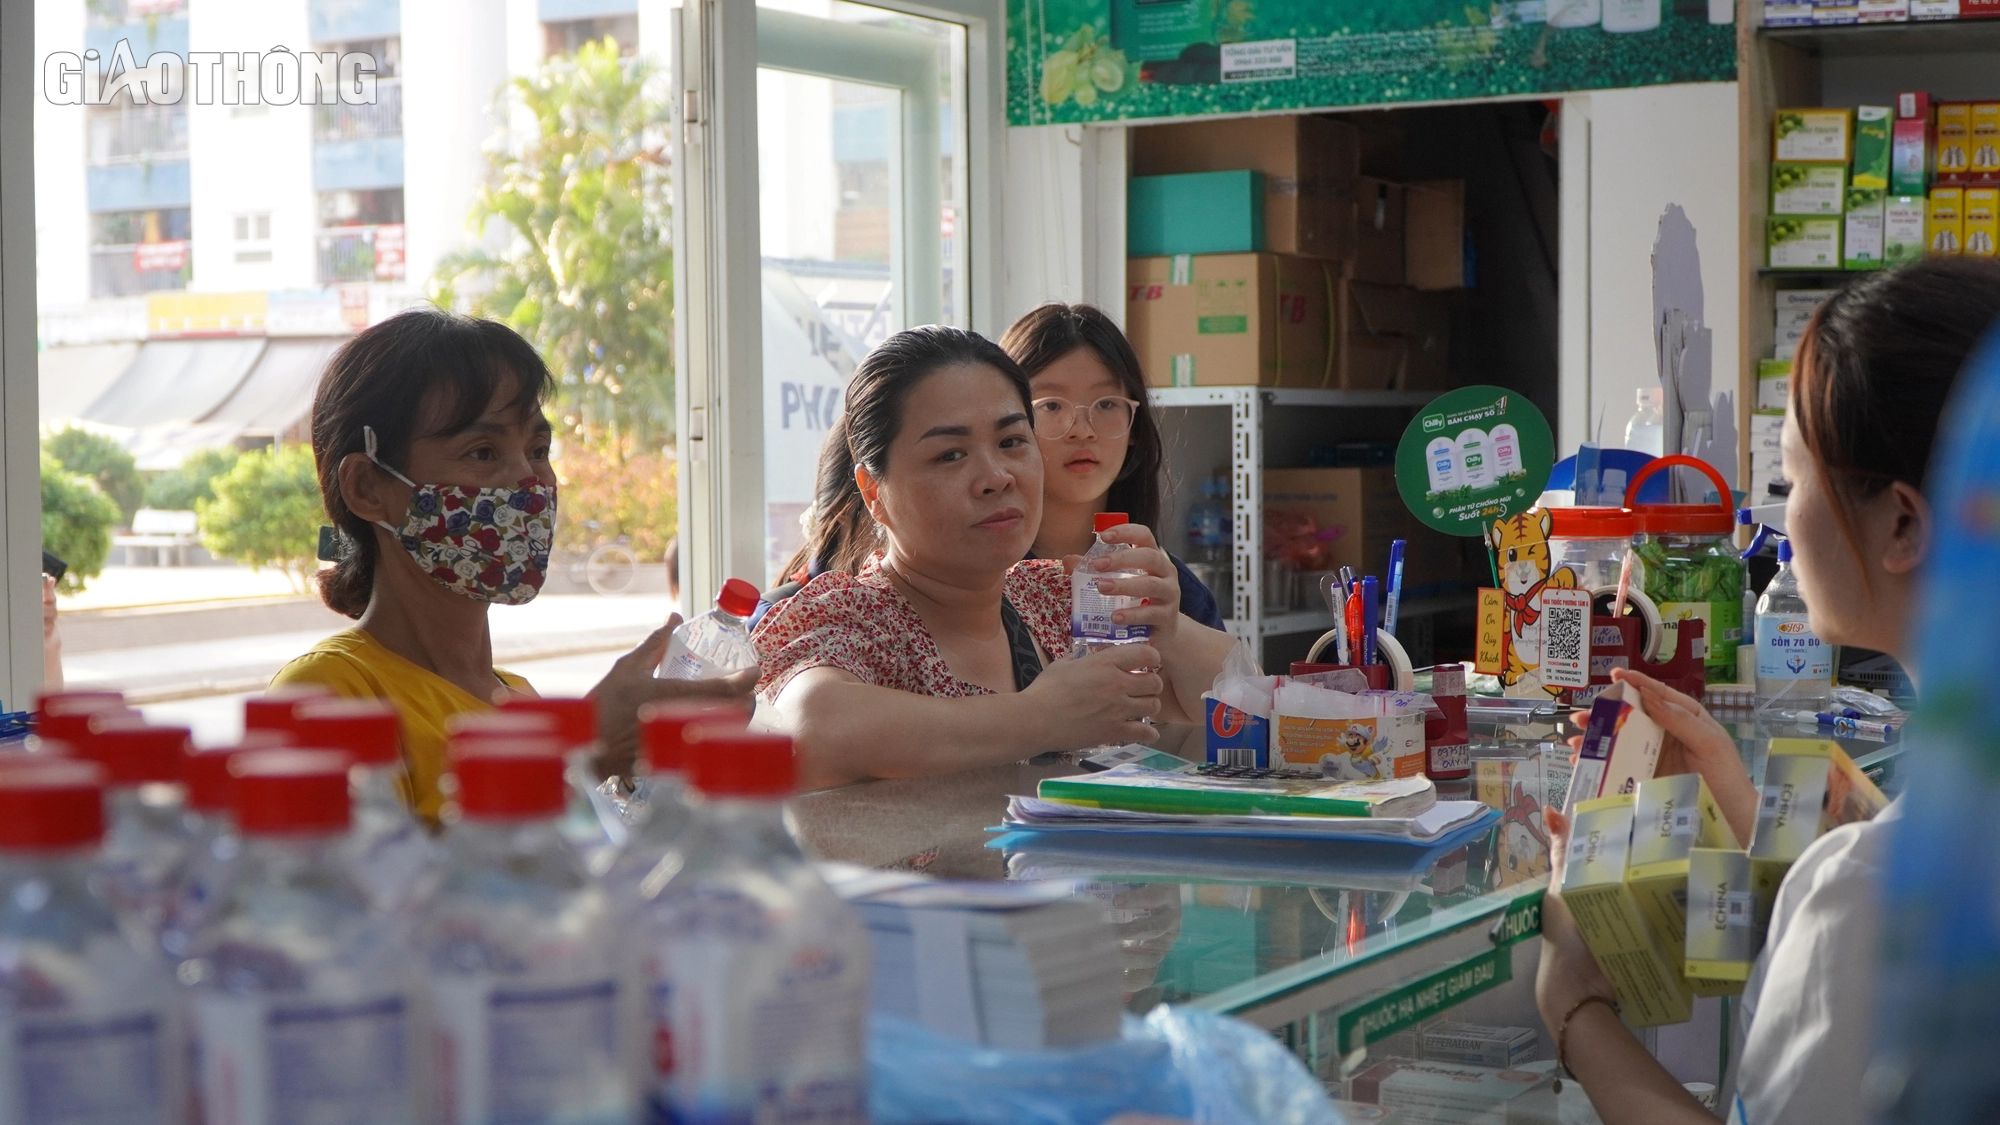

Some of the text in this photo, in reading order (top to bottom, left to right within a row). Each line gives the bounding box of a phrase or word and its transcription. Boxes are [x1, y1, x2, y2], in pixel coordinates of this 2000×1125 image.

[1424, 418, 1443, 429] Chilly
[1447, 416, 1463, 426] BÁN
[1463, 412, 1484, 421] CHẠY
[1484, 407, 1496, 418] SỐ
[1475, 498, 1499, 509] CHỐNG
[1499, 495, 1512, 504] MÙI
[1458, 507, 1499, 521] Suốt 24h
[1550, 597, 1563, 605] THUỐC
[1771, 635, 1820, 649] CỒN 70 ĐỘ
[1479, 650, 1500, 664] Khách
[1774, 783, 1795, 830] ECHINA
[1660, 799, 1675, 838] ECHINA
[1714, 881, 1728, 931] ECHINA
[1499, 904, 1540, 943] THUỐC
[1415, 981, 1446, 1009] NHIỆT
[1447, 967, 1475, 997] GIẢM
[1474, 959, 1496, 985] ĐAU
[1425, 1036, 1482, 1050] EFFERALGAN
